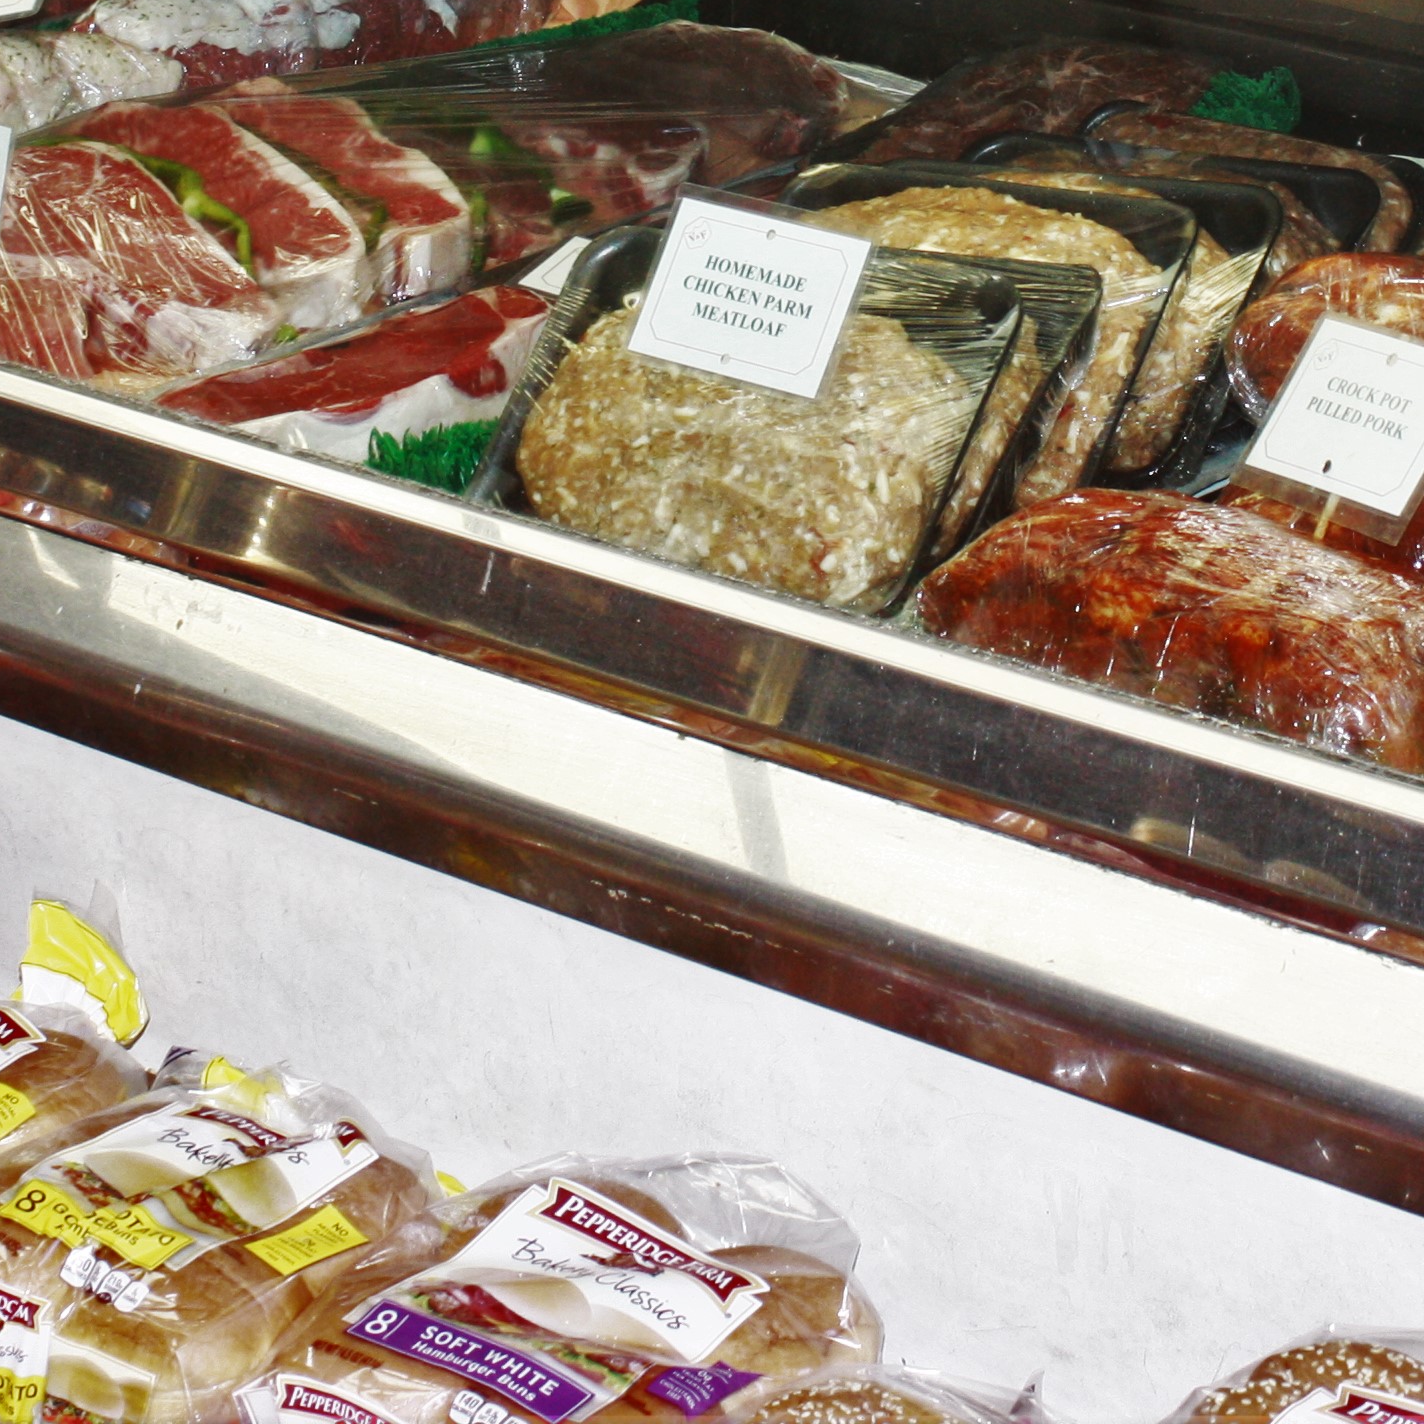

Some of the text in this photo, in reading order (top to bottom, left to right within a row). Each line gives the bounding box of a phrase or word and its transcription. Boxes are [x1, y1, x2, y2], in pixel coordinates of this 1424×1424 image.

[704, 254, 808, 292] HOMEMADE
[683, 274, 814, 320] CHICKEN PARM
[691, 302, 788, 338] MEATLOAF
[1326, 376, 1413, 416] CROCK POT
[1306, 395, 1409, 441] PULLED PORK
[3, 1093, 19, 1104] NO
[15, 1189, 46, 1213] 8
[332, 1222, 349, 1237] NO
[553, 1194, 732, 1290] PEPPERIDGE FARM
[511, 1235, 690, 1331] Bakery Classics
[363, 1309, 556, 1397] 8 SOFT WHITE
[411, 1339, 536, 1403] Hamburger Buns
